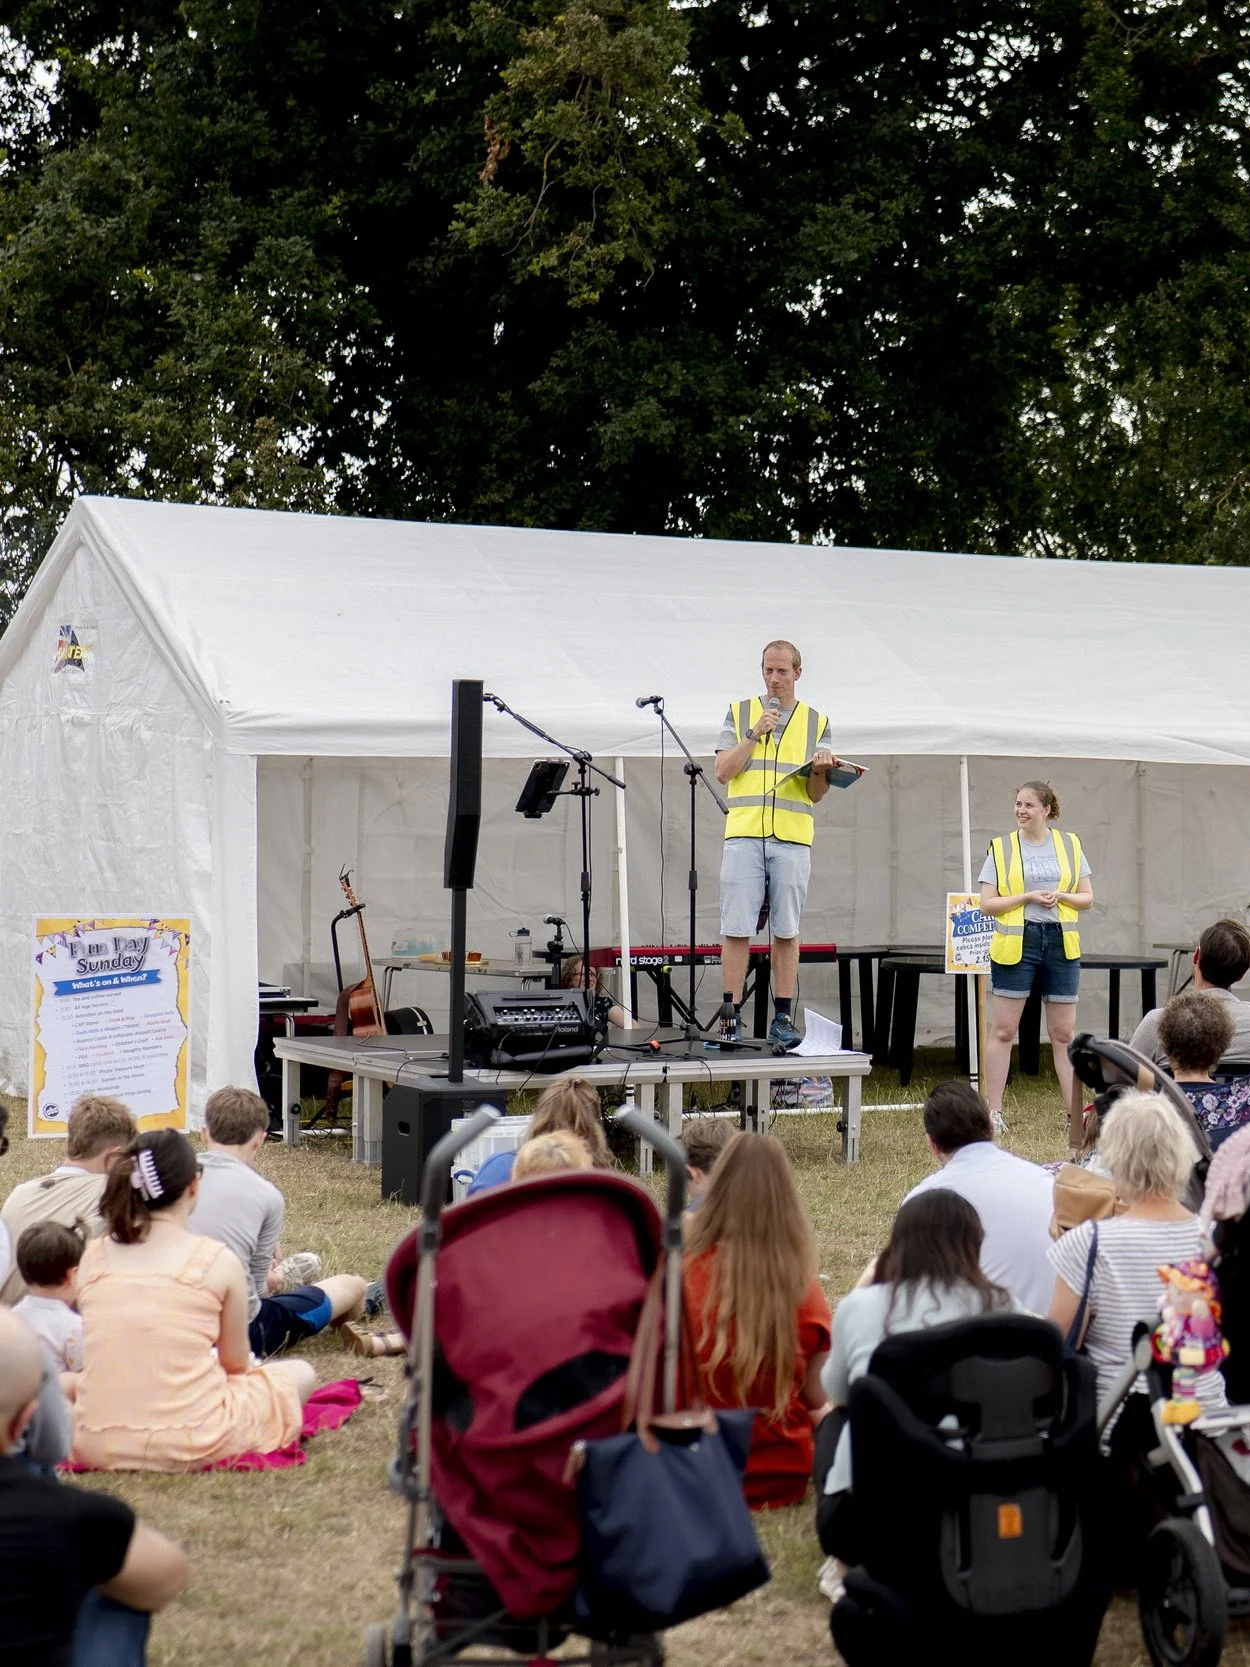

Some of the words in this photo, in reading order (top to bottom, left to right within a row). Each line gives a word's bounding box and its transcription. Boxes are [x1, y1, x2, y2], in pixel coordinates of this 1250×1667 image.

[113, 936, 150, 953] Day
[76, 953, 145, 974] Sunday
[72, 979, 101, 989] What's
[113, 977, 120, 985] &
[121, 974, 147, 984] When?
